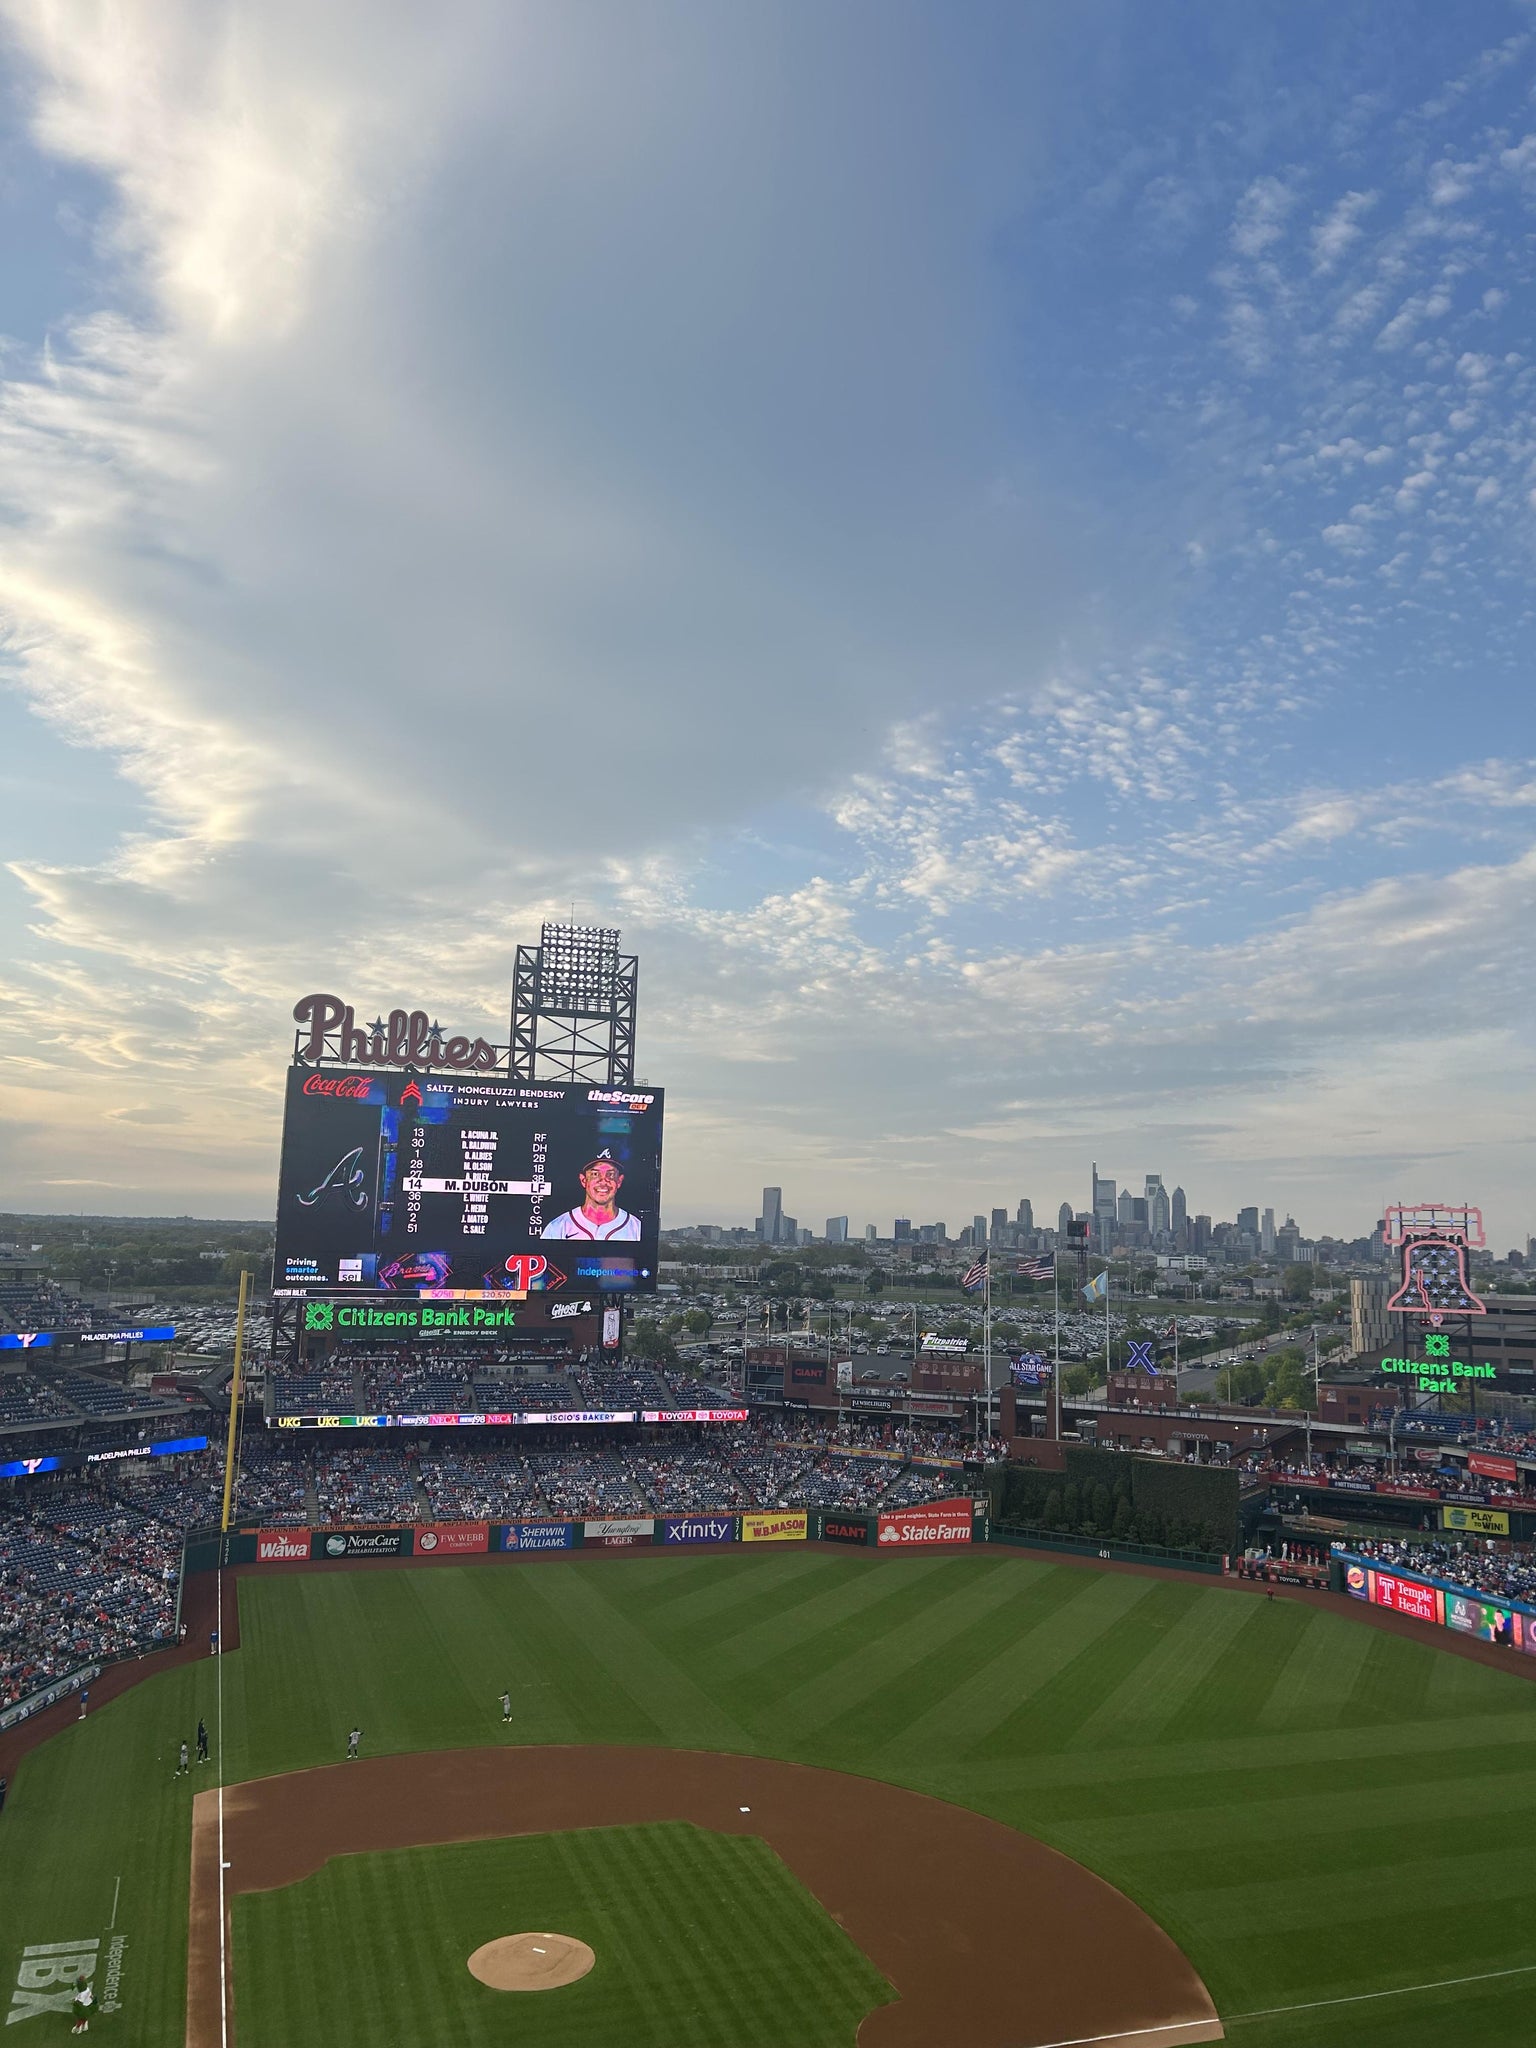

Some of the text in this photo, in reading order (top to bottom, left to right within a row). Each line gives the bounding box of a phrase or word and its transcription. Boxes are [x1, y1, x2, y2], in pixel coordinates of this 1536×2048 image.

[293, 993, 497, 1072] Phillies
[426, 1084, 565, 1099] SALTZ MONGELUZZI BENDESKY
[587, 1090, 655, 1104] theScore
[453, 1097, 539, 1109] INJURY LAWYERS
[413, 1128, 425, 1137] 13
[534, 1133, 547, 1142] RF
[411, 1138, 425, 1148] 30
[532, 1143, 547, 1153] DH
[415, 1150, 420, 1158] 1
[532, 1154, 546, 1163] 2B
[410, 1160, 424, 1169] 28
[472, 1162, 493, 1171] OLSON
[533, 1164, 545, 1173] 1B
[410, 1170, 423, 1179] 27
[532, 1175, 545, 1183] 3B
[408, 1179, 422, 1190] 14
[444, 1181, 460, 1191] M.
[530, 1183, 546, 1193] LF
[408, 1191, 421, 1201] 36
[469, 1194, 489, 1203] WHITE
[530, 1196, 544, 1204] CF
[407, 1202, 421, 1211] 20
[533, 1206, 541, 1214] C
[410, 1213, 417, 1222] 2
[467, 1215, 489, 1224] MATEO
[529, 1216, 543, 1225] SS
[407, 1223, 418, 1233] 51
[469, 1225, 486, 1234] SALE
[286, 1258, 317, 1267] Driving
[285, 1274, 329, 1282] outcomes.
[551, 1302, 583, 1319] GHOST
[337, 1307, 515, 1327] Citizens Bank Park
[81, 1331, 144, 1341] PHILADELPHIA PHILLIES
[1009, 1361, 1053, 1373] ALL STAR GAME
[1381, 1357, 1497, 1379] Citizens Bank
[794, 1368, 824, 1377] GIANT
[1419, 1377, 1458, 1394] Park
[488, 1415, 512, 1423] NECA
[545, 1413, 615, 1422] LISCIO'S BAKERY
[661, 1411, 694, 1420] TOYOTA
[712, 1411, 744, 1419] TOYOTA
[278, 1417, 301, 1427] UKG
[317, 1417, 340, 1427] UKG
[356, 1416, 378, 1426] UKG
[432, 1416, 458, 1424] NECA
[1182, 1432, 1209, 1440] TOYOTA
[87, 1447, 151, 1462] PHILADELPHIA PHILLIES
[1471, 1512, 1493, 1521] PLAY
[598, 1523, 641, 1535] Yuengling
[669, 1519, 729, 1541] xfinity
[825, 1523, 866, 1538] GIANT
[1482, 1522, 1503, 1531] WIN!
[521, 1527, 565, 1537] SHERWIN
[347, 1534, 400, 1548] NovaCare
[458, 1533, 485, 1542] WEBB
[604, 1537, 633, 1545] LAGER
[260, 1541, 307, 1558] Wawa
[1098, 1549, 1110, 1558] 401
[1279, 1576, 1300, 1584] TOYOTA
[1397, 1581, 1432, 1603] Temple
[1398, 1597, 1431, 1618] Health
[103, 1935, 129, 2000] Independence
[5, 1938, 100, 2025] IBX
